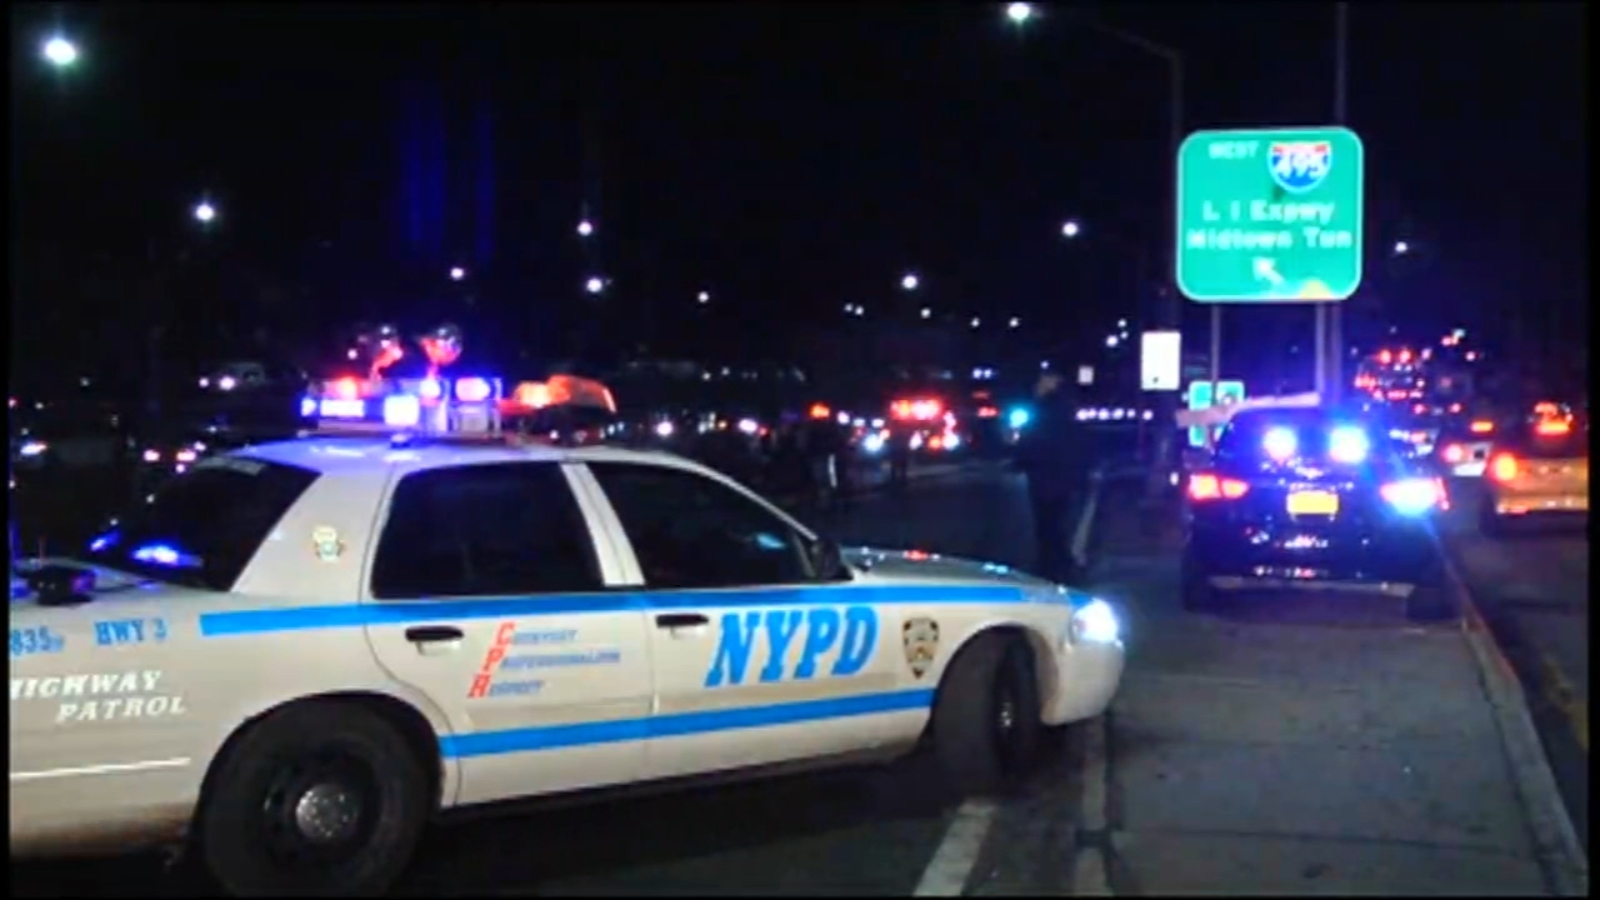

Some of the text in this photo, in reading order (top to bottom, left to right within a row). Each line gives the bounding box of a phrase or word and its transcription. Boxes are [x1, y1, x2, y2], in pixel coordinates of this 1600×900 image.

[1275, 153, 1328, 178] 495
[1203, 201, 1220, 221] L
[1251, 200, 1335, 225] Expwy
[1186, 226, 1353, 250] Midtown Tun
[95, 619, 166, 645] HWY 3
[704, 606, 878, 687] NYPD
[56, 697, 187, 724] PATROL
